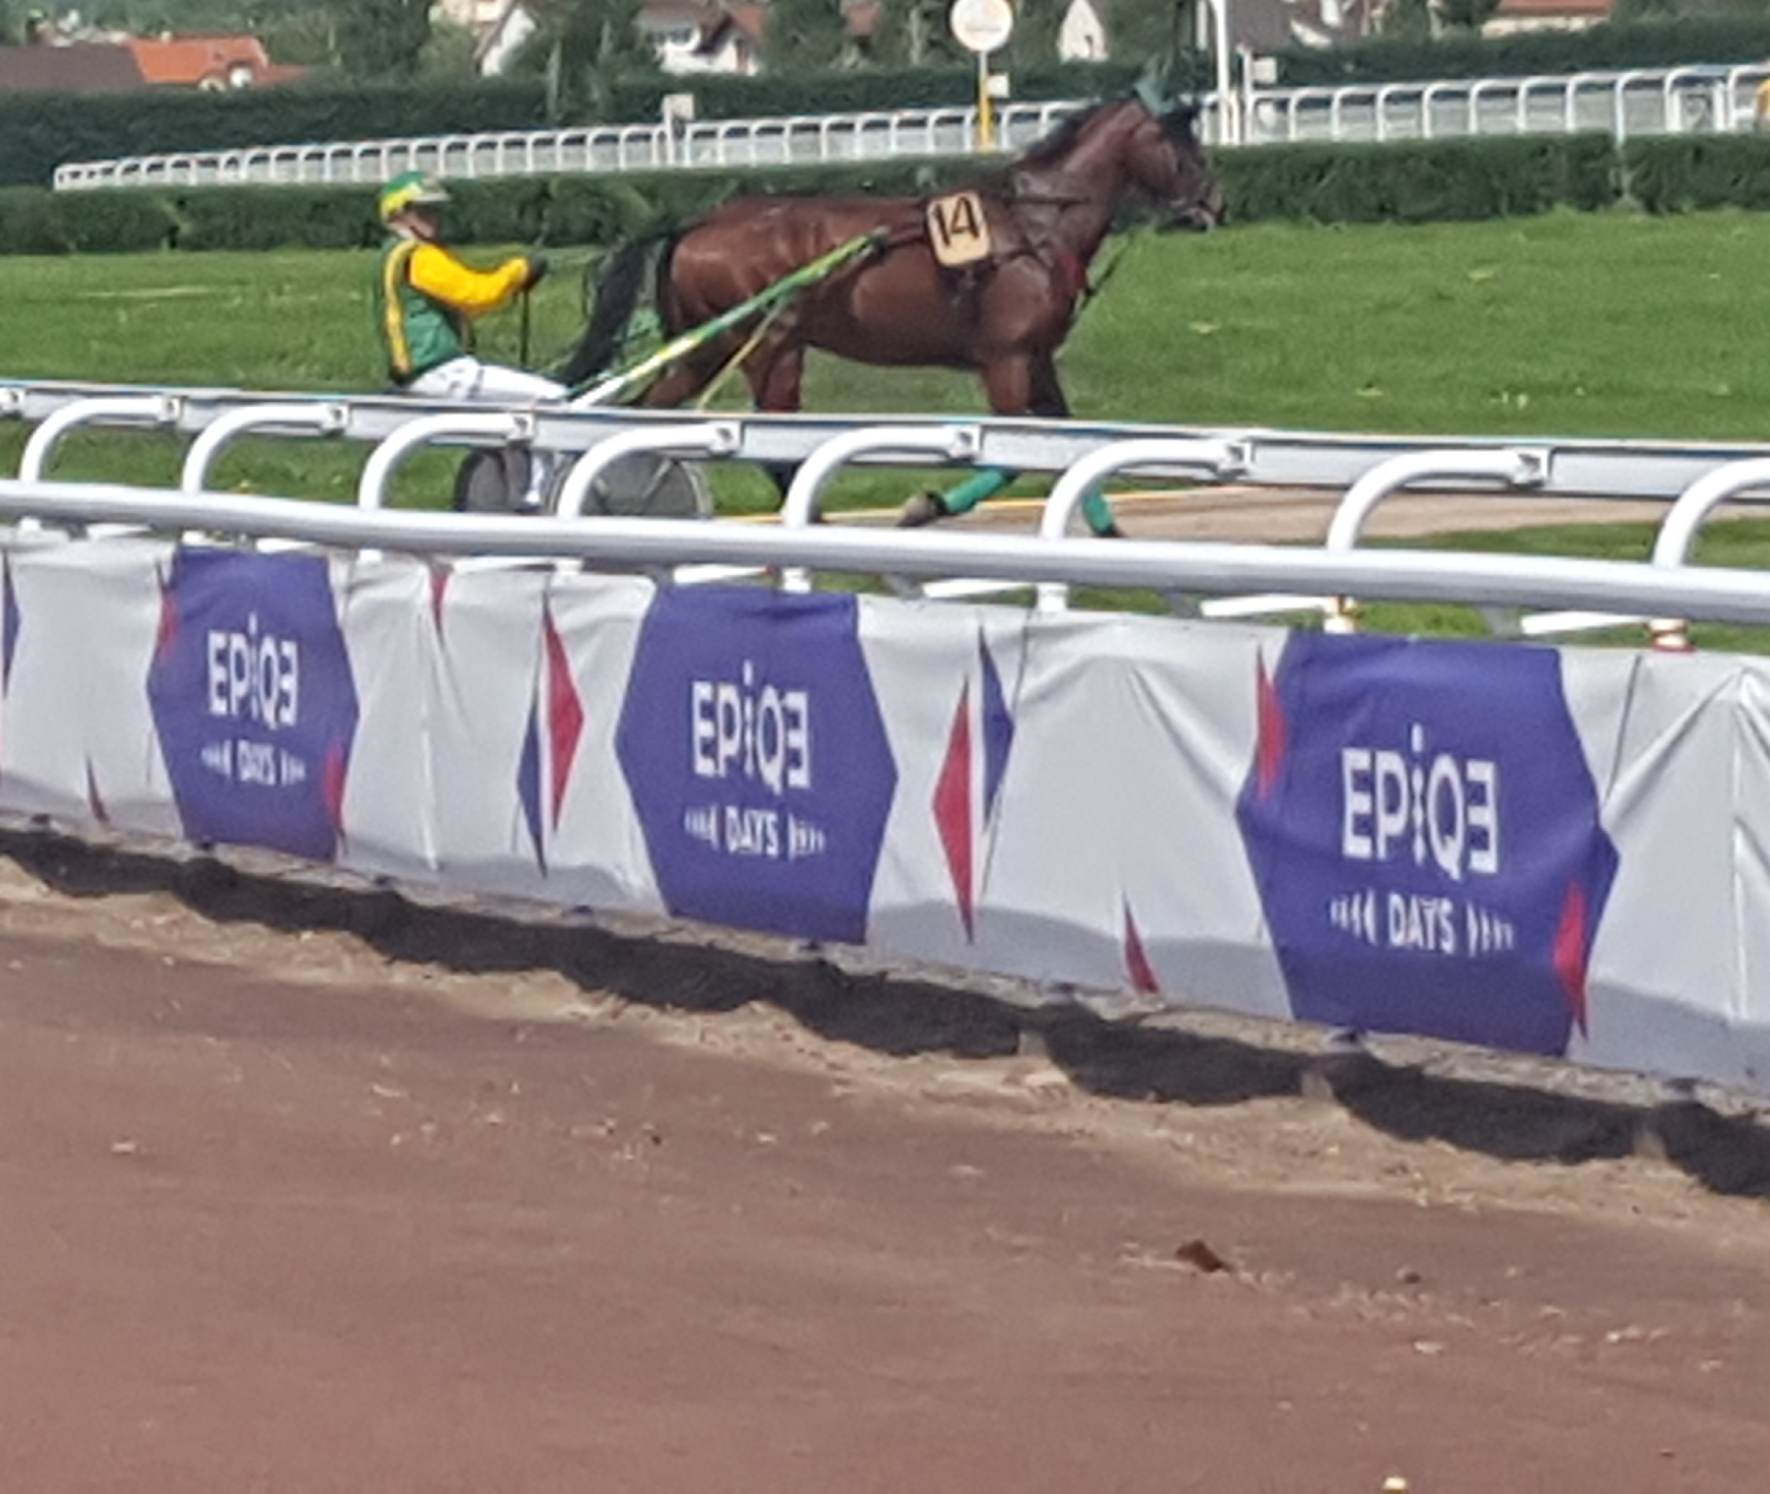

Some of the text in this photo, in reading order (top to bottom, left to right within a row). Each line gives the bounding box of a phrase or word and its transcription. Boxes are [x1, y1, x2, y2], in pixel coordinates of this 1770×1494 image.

[934, 196, 979, 246] 14
[725, 805, 779, 858] DAYS
[1388, 892, 1455, 954] DAYS
